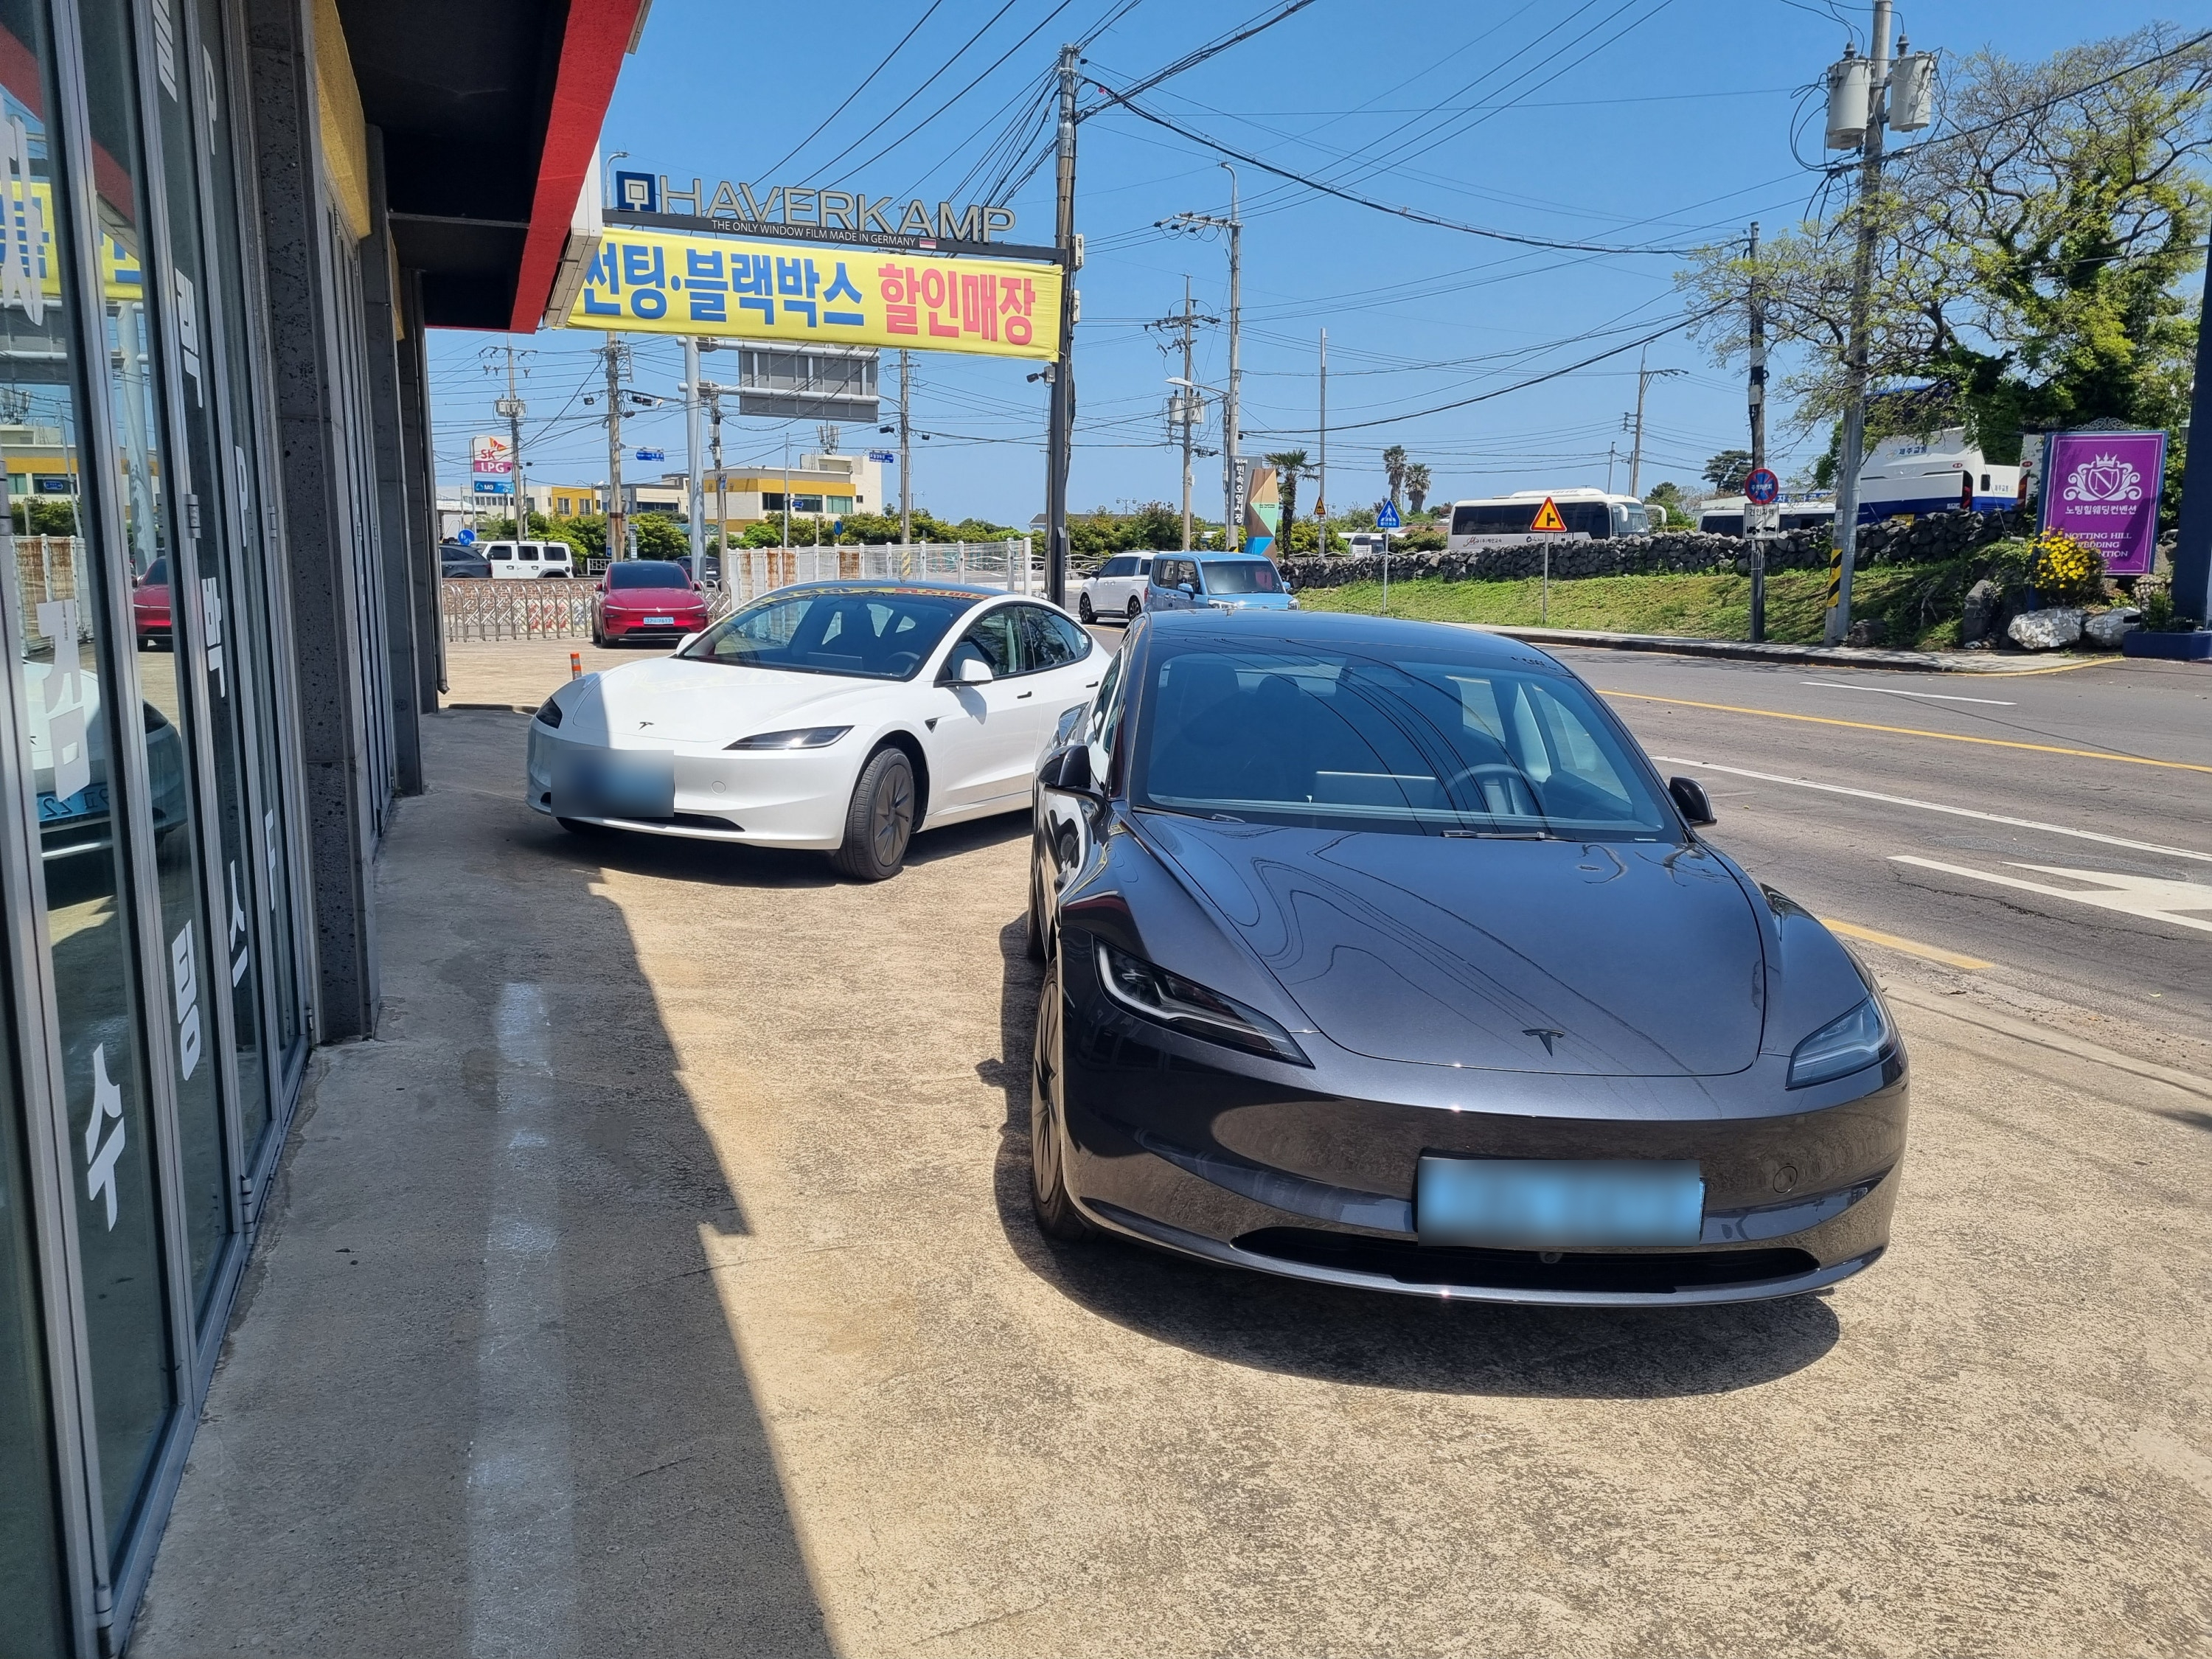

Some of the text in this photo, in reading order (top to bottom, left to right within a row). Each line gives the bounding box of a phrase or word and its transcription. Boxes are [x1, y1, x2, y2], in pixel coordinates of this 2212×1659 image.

[659, 175, 1016, 246] HAVERKAMP
[712, 220, 916, 247] THE ONLY WINDOW FILM MADE IN GERMANY
[877, 263, 1036, 346] 할인매장
[481, 449, 495, 460] SK
[481, 462, 504, 473] LPG
[2094, 472, 2115, 490] N
[1234, 465, 1245, 524] 민속오일시장
[2065, 505, 2137, 515] 노팅힐웨딩컨벤션
